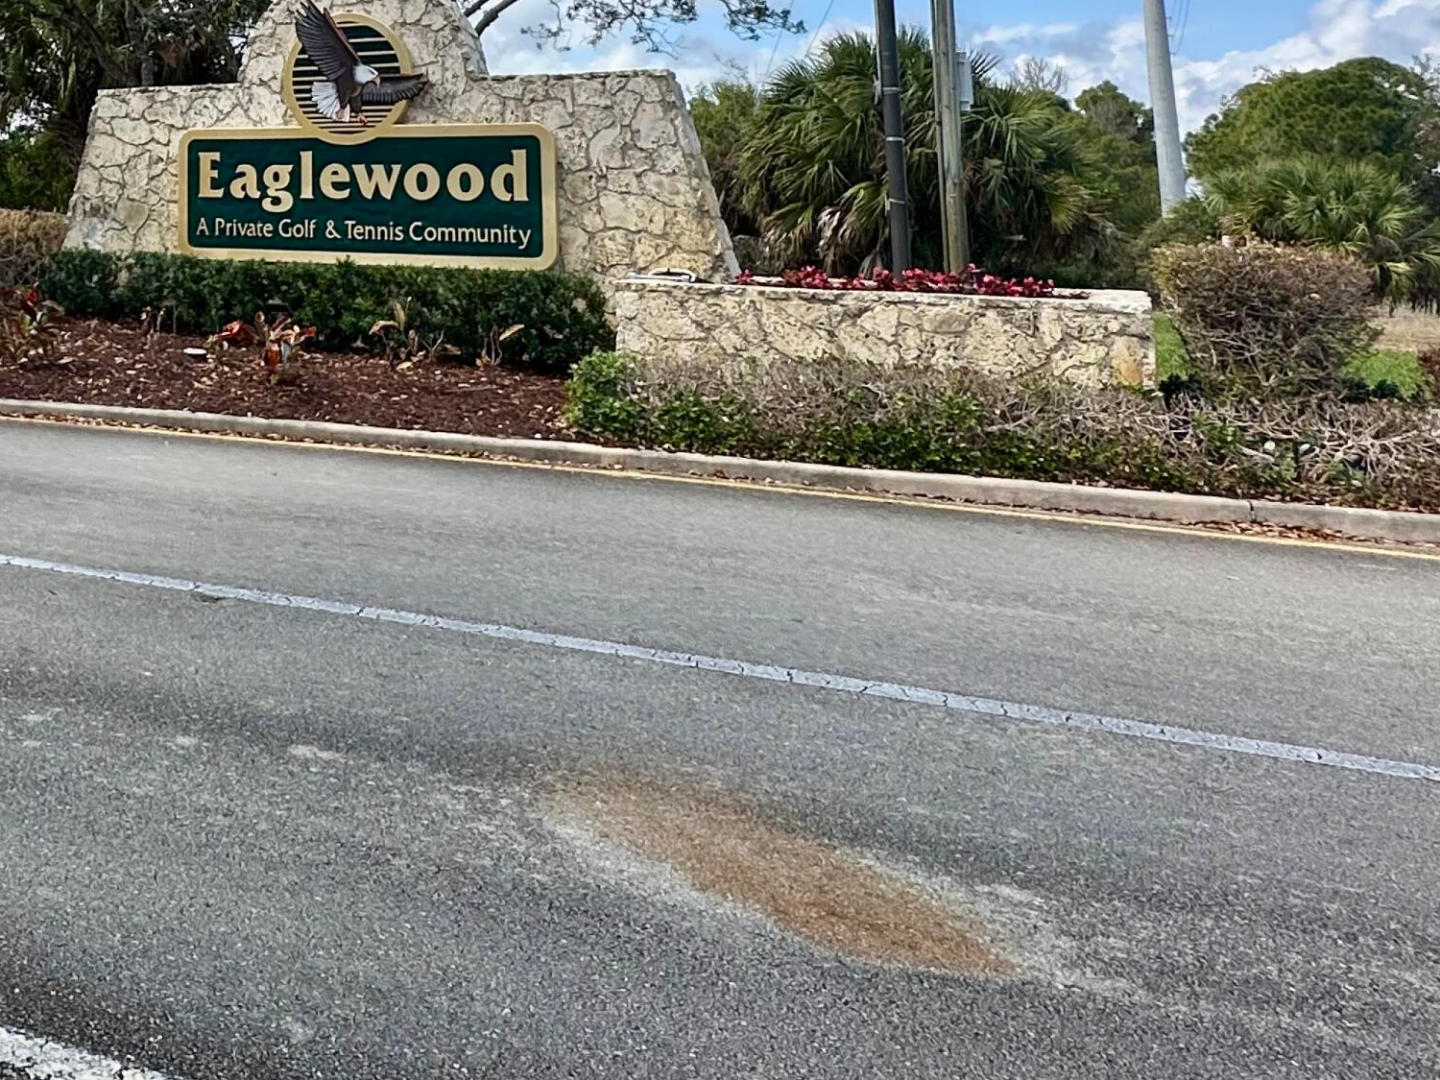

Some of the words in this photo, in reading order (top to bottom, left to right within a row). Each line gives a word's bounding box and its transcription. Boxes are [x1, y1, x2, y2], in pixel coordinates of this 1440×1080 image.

[197, 148, 530, 213] Eaglewood
[195, 218, 210, 236] A
[214, 218, 273, 238] Private
[278, 218, 316, 239] Golf
[324, 220, 342, 239] &
[344, 220, 404, 242] Tennis
[408, 221, 532, 250] Community
